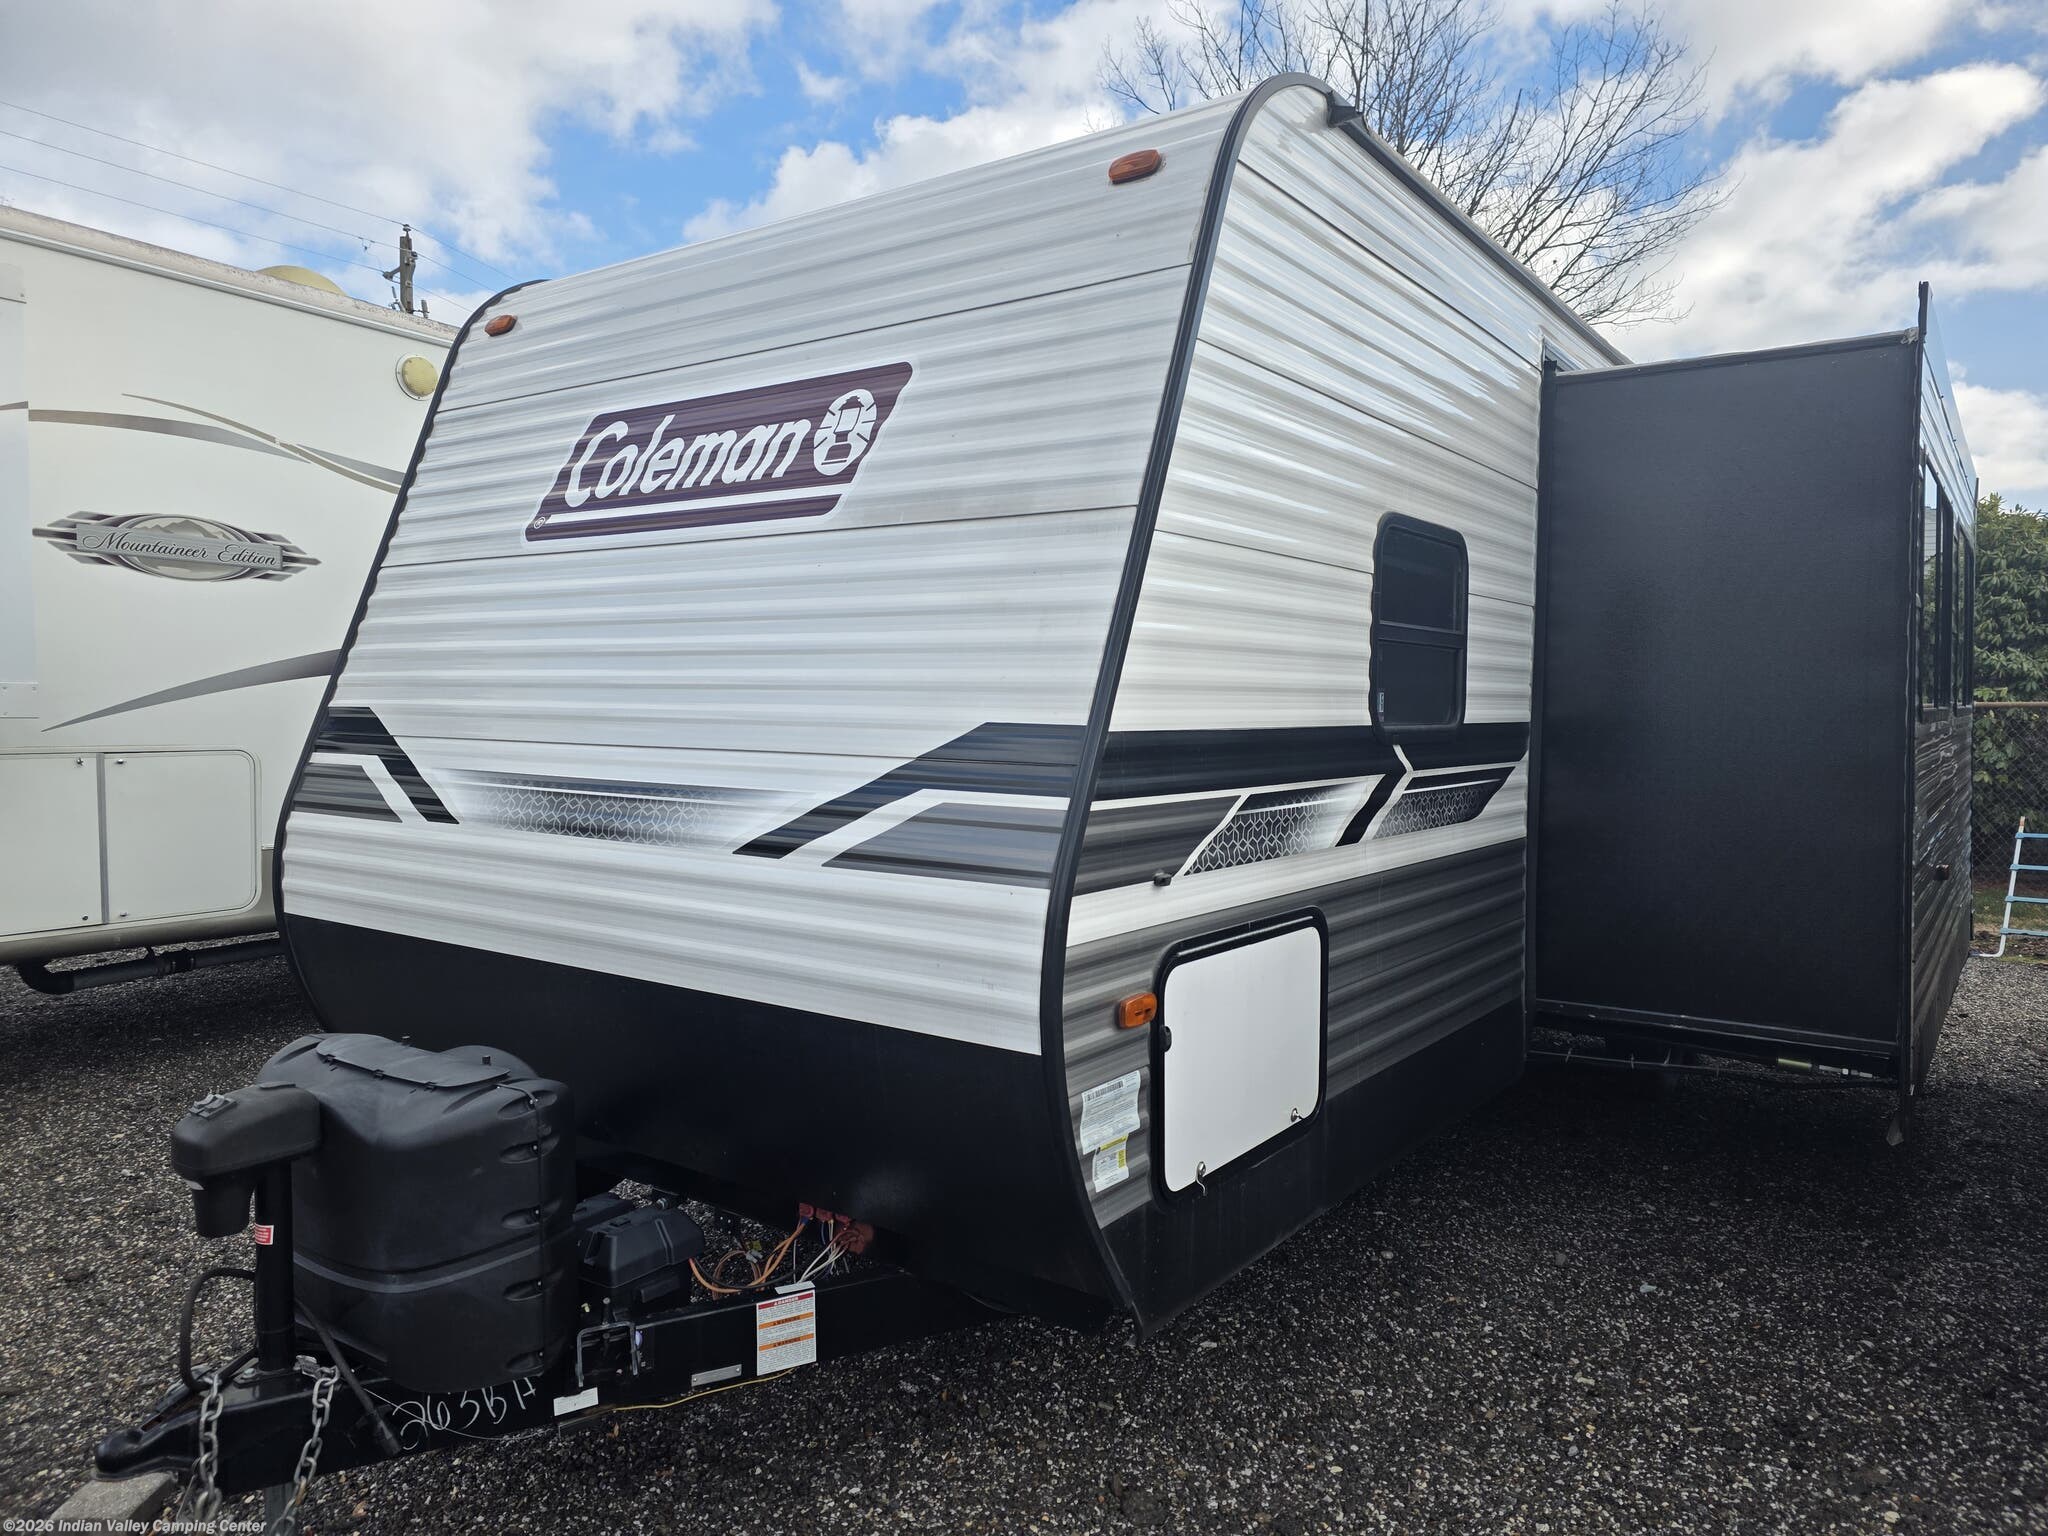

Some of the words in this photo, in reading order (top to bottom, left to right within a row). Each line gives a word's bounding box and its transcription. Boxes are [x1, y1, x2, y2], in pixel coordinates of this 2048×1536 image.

[564, 413, 812, 508] Coleman
[82, 531, 209, 559] Mountaineer
[217, 543, 277, 566] Edition
